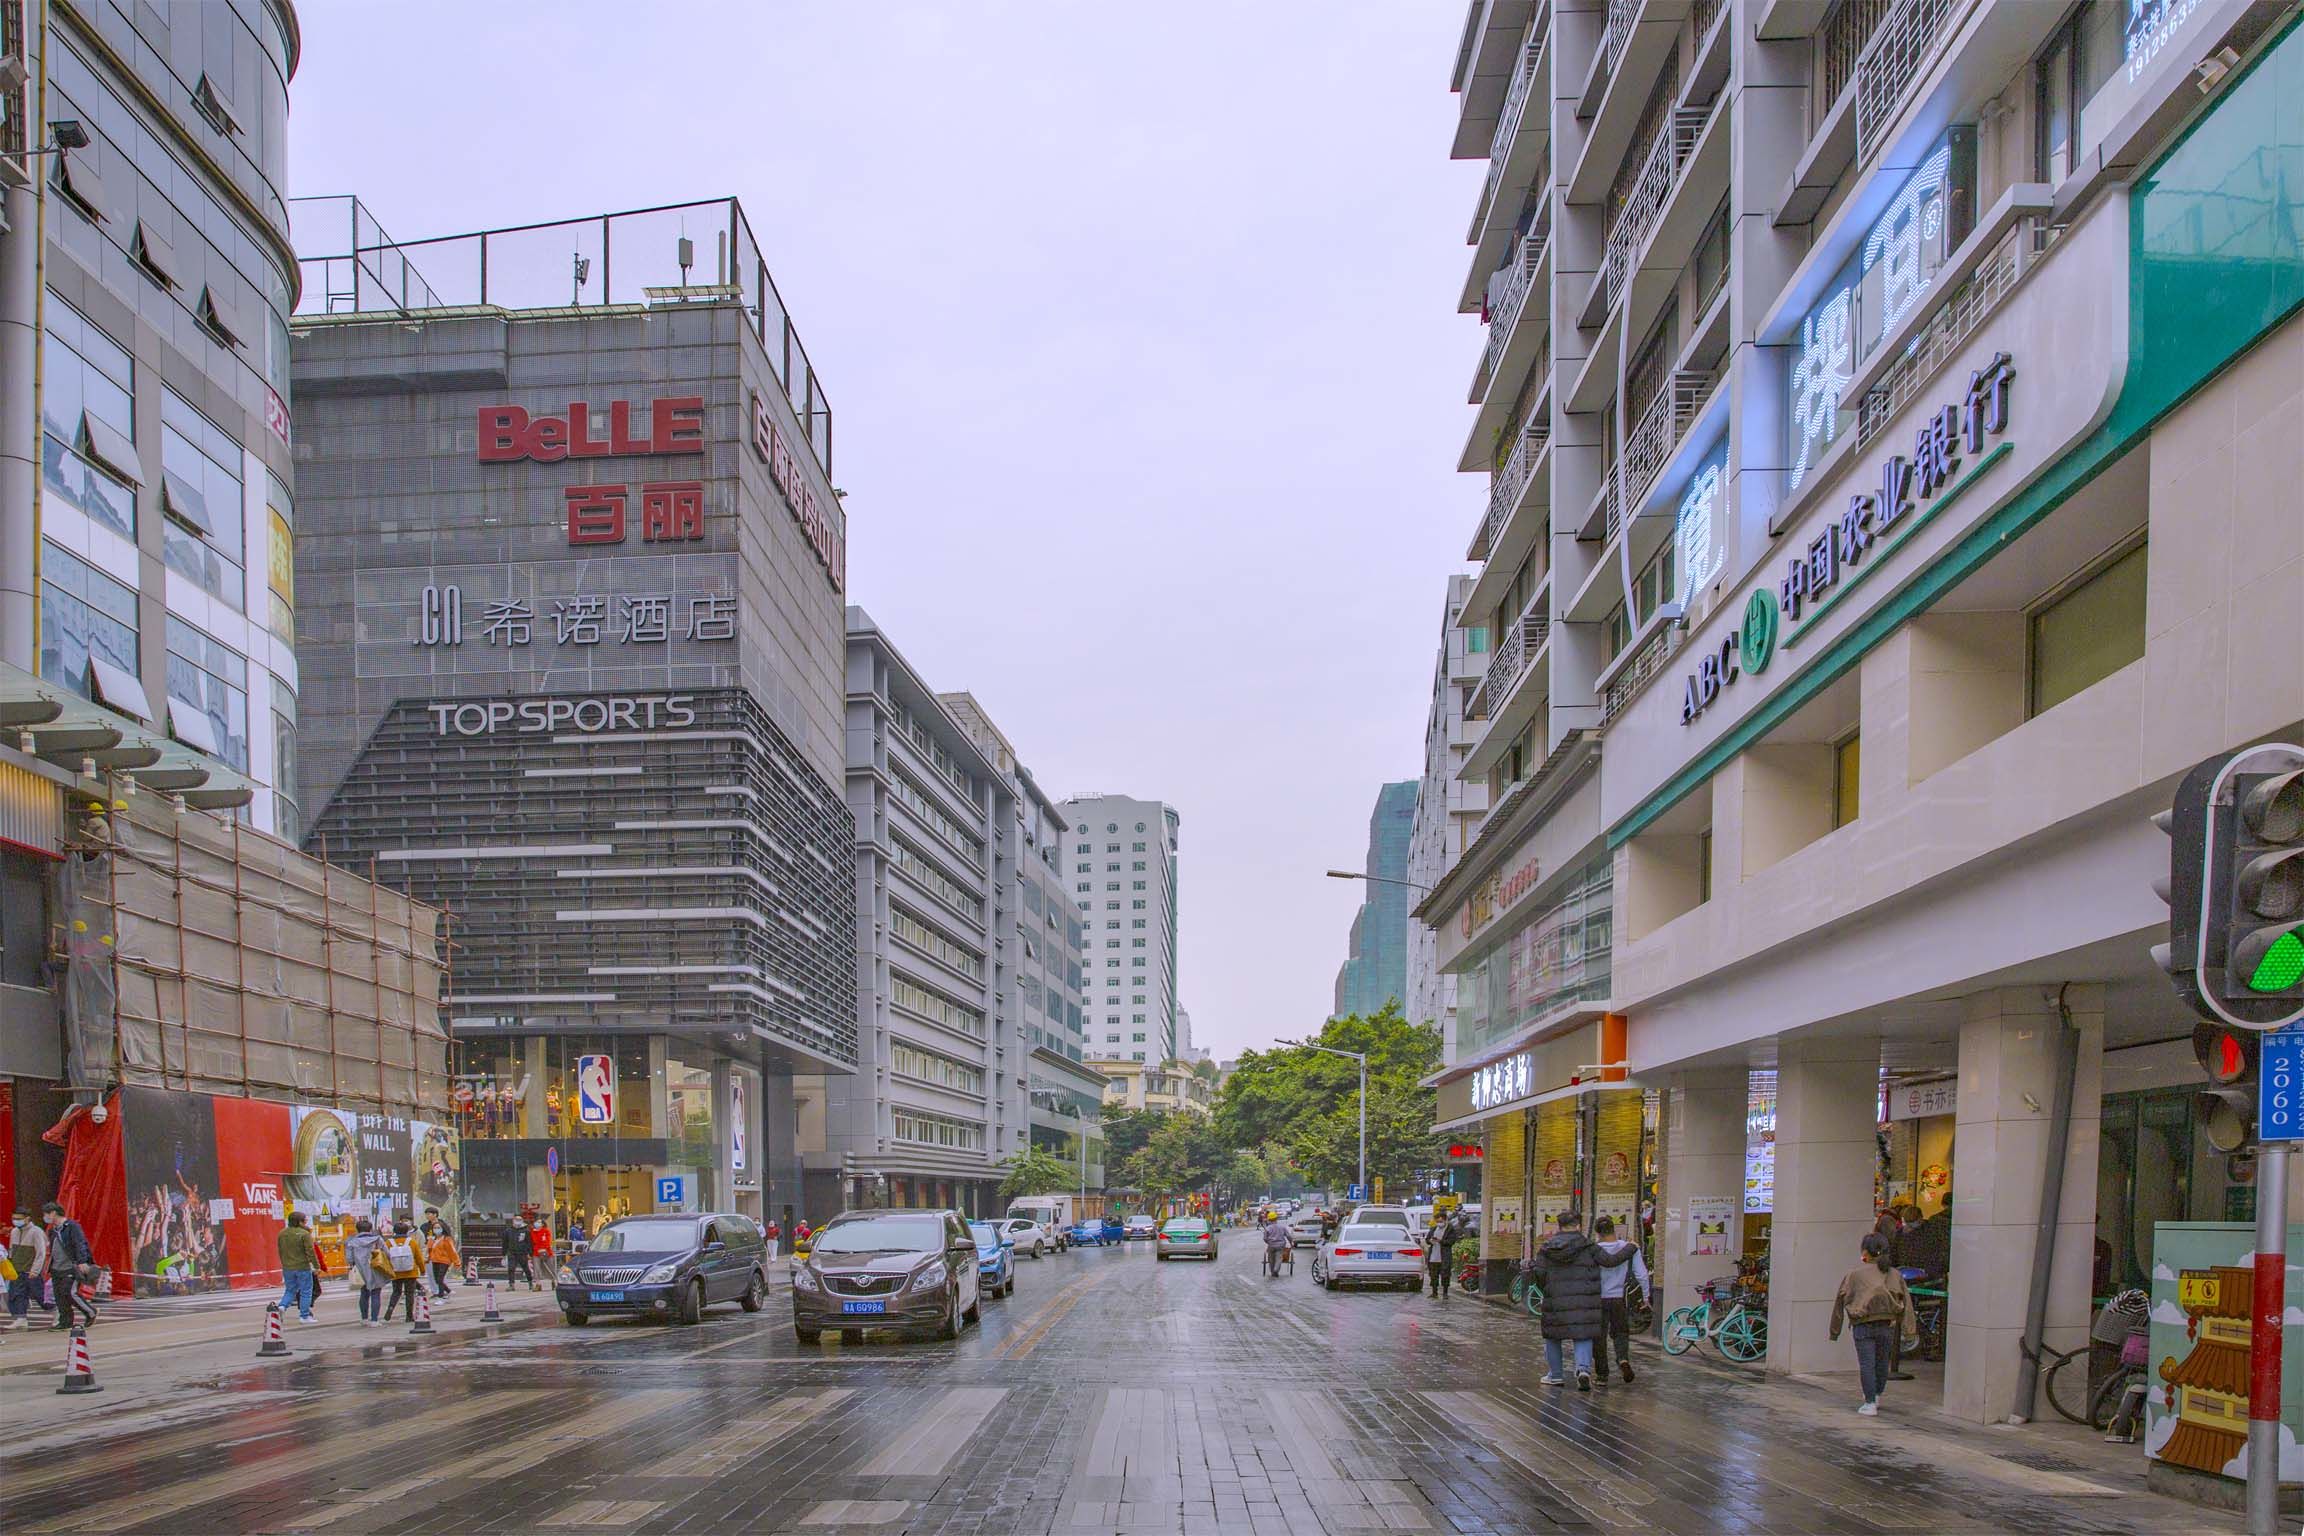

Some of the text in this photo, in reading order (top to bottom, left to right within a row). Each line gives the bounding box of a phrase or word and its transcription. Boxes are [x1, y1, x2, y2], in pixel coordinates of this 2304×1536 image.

[564, 481, 704, 545] 百丽
[1680, 351, 2017, 726] ABC 中国农业银行
[482, 591, 737, 647] 希诺酒店
[427, 696, 696, 736] TOPSPORTS
[2271, 1057, 2290, 1126] 2060
[362, 1132, 396, 1153] WALL.
[364, 1167, 400, 1188] 这就是
[662, 1181, 677, 1200] P
[389, 1192, 409, 1209] THE
